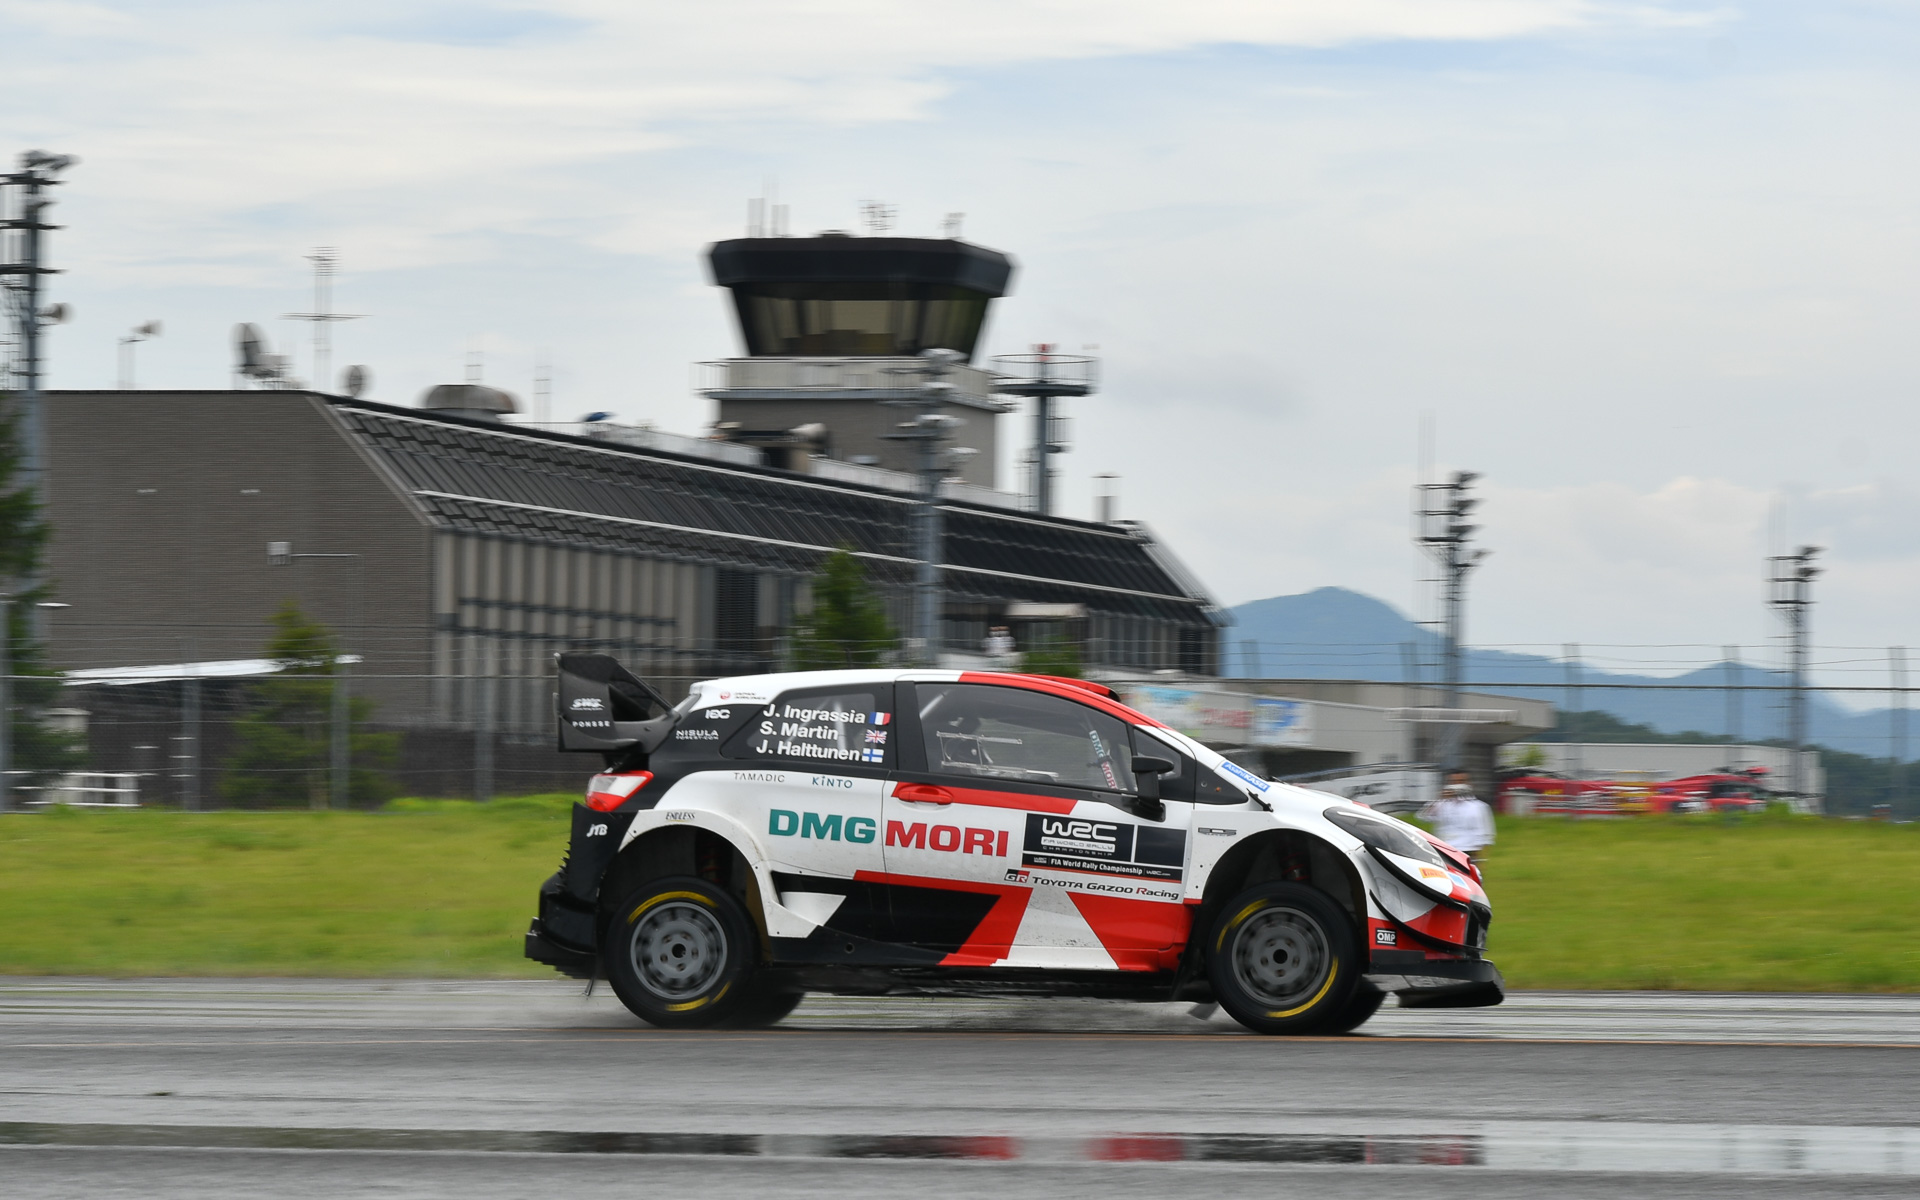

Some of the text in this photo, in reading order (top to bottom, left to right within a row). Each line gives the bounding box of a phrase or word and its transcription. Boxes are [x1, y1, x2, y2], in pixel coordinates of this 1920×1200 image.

[763, 704, 866, 724] J. Ingrassia
[676, 729, 719, 737] NISULA
[760, 721, 839, 741] S. Martin
[756, 740, 860, 761] J. Halttunen
[734, 772, 785, 783] TAMADIC
[812, 775, 853, 789] KINTO
[665, 812, 696, 821] ENDLESS
[586, 824, 608, 838] JTB
[768, 808, 876, 844] DMG
[1042, 818, 1118, 842] WRC
[885, 820, 1009, 857] MORI
[1051, 858, 1143, 875] FIA World Rally Championship
[1032, 876, 1179, 901] TOYOTA GAZOO Racing
[1377, 932, 1396, 942] OMP
